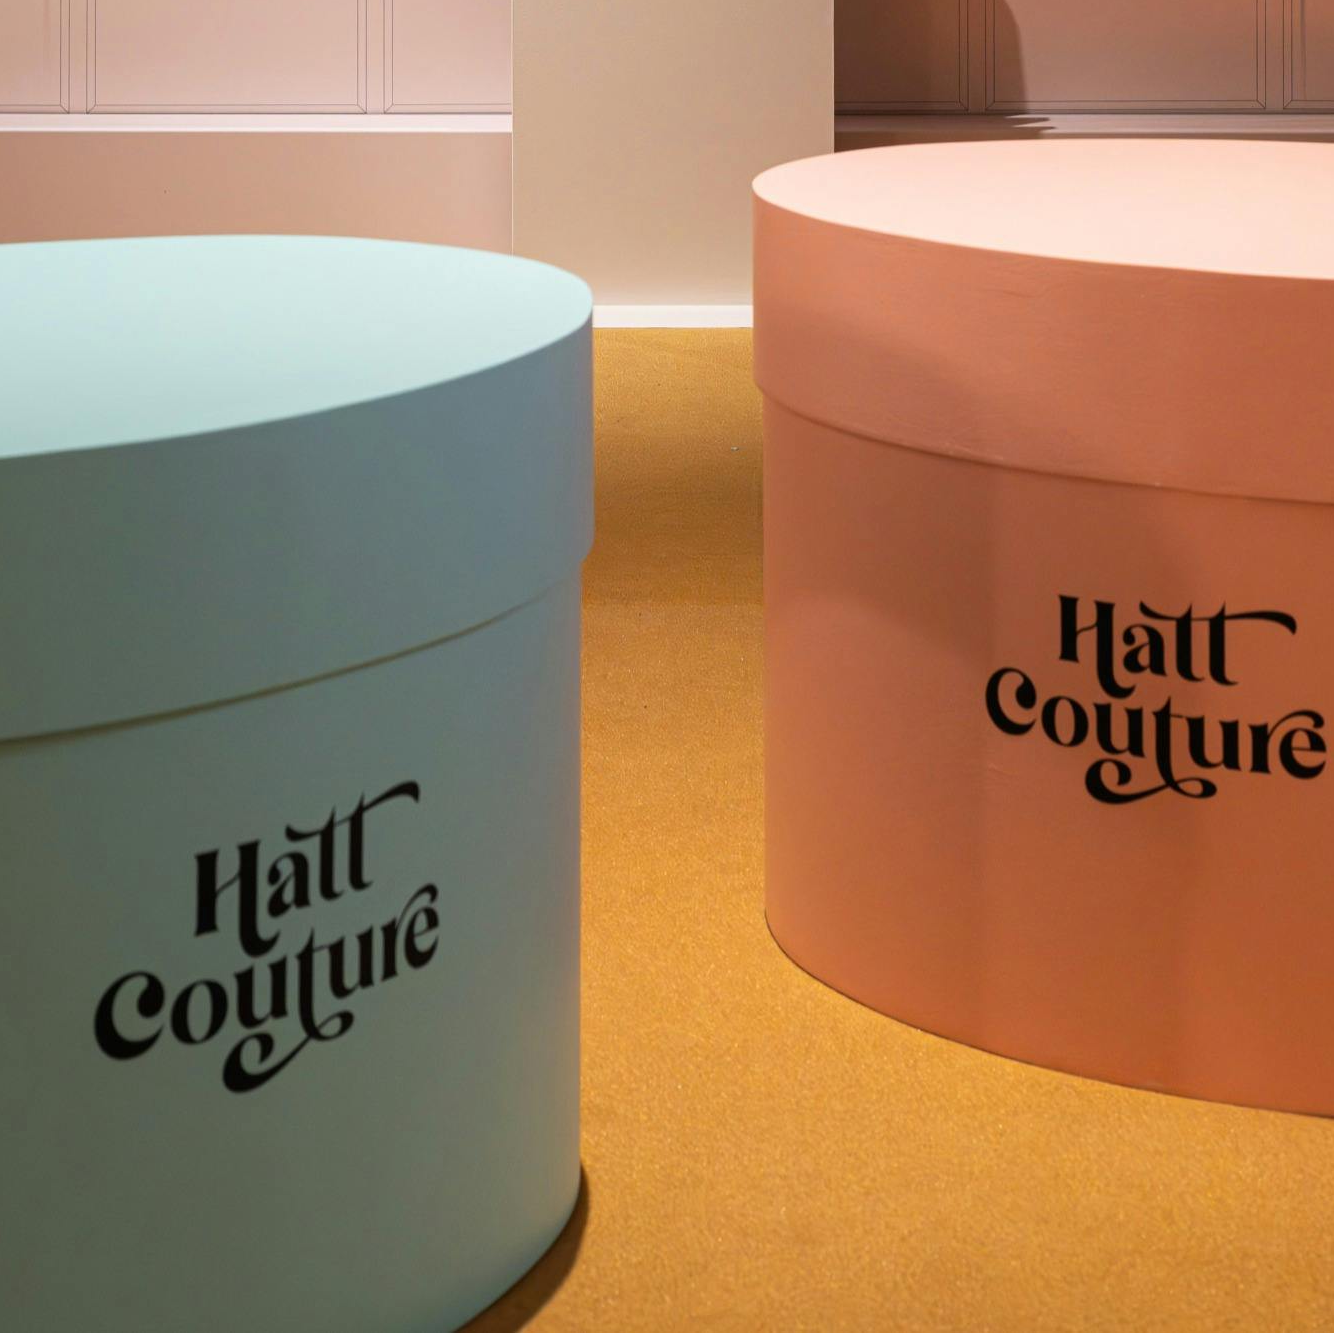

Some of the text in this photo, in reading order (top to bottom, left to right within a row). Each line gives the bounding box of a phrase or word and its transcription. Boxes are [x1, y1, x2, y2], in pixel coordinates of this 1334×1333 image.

[1058, 594, 1297, 699] Hatt
[985, 667, 1327, 804] Couture
[194, 780, 420, 957] Hatt
[93, 883, 440, 1094] Couture
